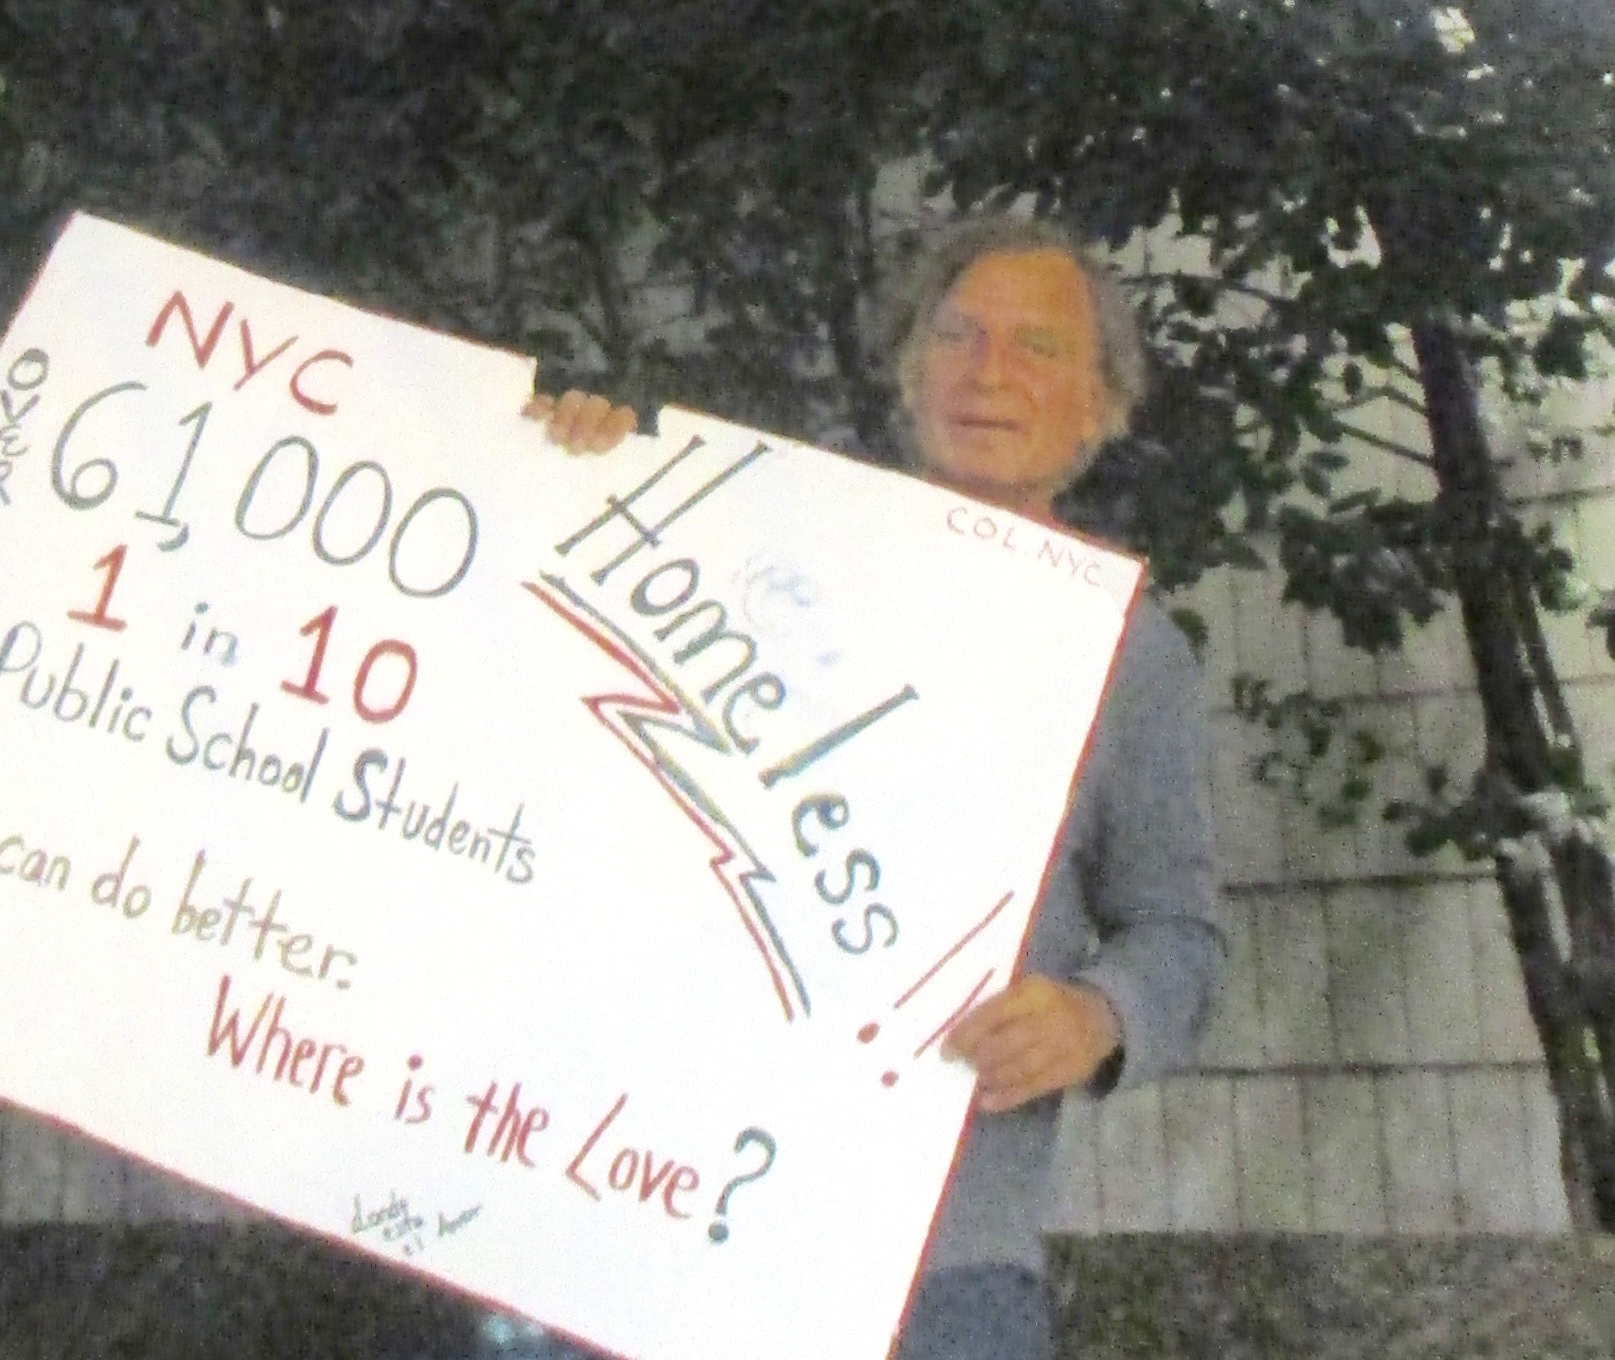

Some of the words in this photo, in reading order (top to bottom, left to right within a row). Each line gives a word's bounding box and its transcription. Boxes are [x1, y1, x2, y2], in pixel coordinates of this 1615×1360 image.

[145, 289, 354, 416] NYC
[50, 381, 479, 599] 61,000
[1038, 540, 1102, 588] NYC
[67, 544, 128, 633] 1
[180, 602, 238, 667] in
[281, 605, 418, 724] 10
[165, 685, 330, 803] School
[334, 747, 537, 885] Students
[90, 835, 153, 920] do
[206, 973, 365, 1108] Where
[394, 1053, 436, 1126] is
[464, 1080, 550, 1168] the
